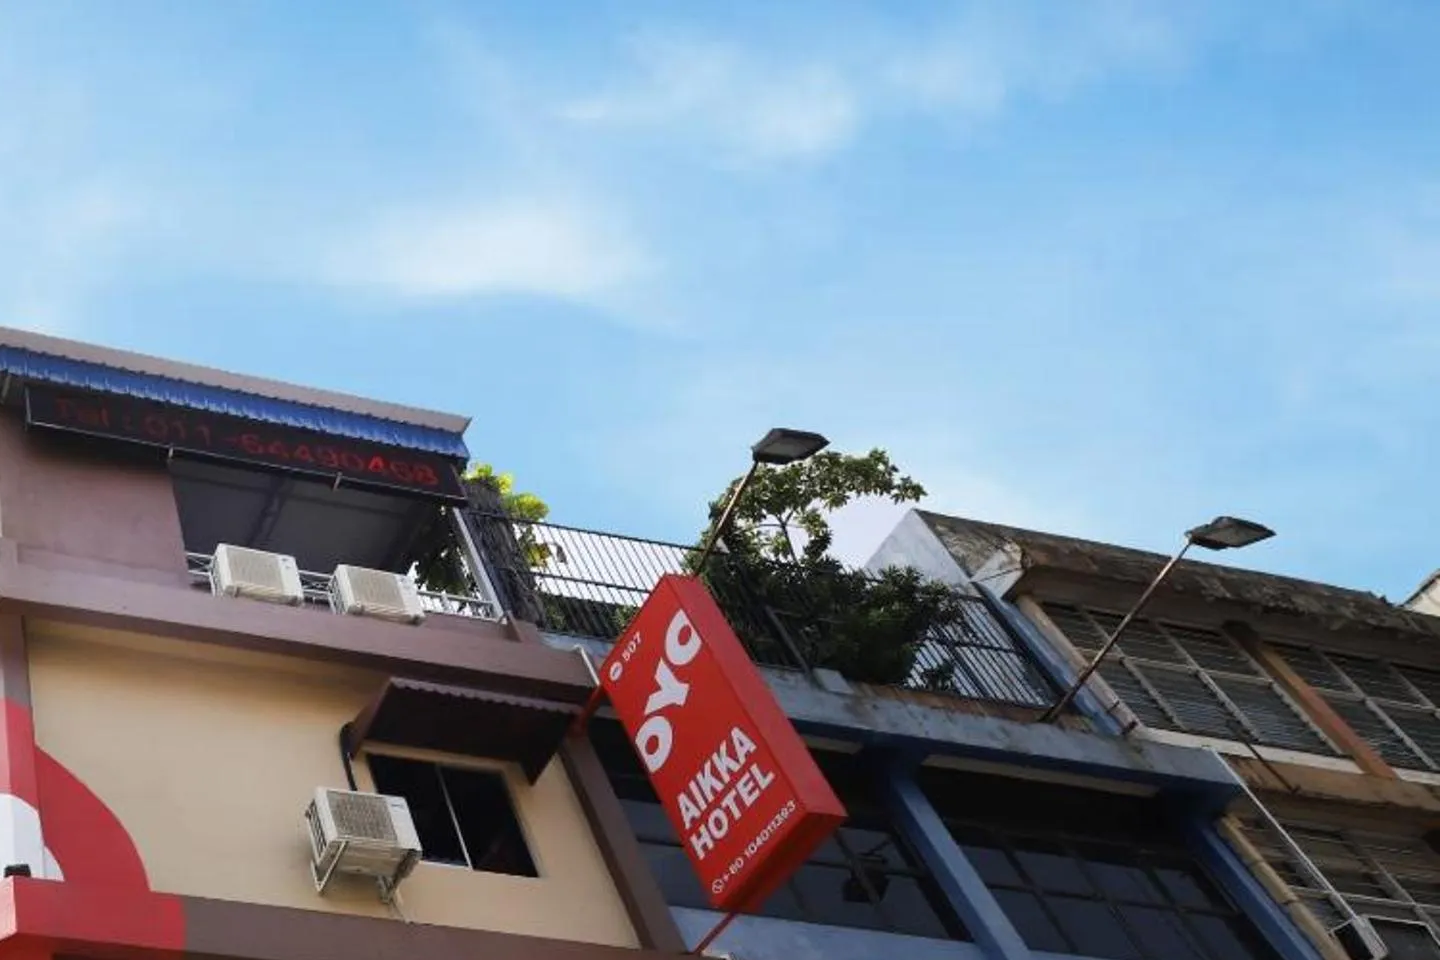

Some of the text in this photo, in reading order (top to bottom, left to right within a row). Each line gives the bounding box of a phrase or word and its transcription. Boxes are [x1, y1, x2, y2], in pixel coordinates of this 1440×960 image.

[635, 608, 702, 773] OYO
[676, 726, 757, 830] AIKKA
[689, 763, 775, 860] HOTEL
